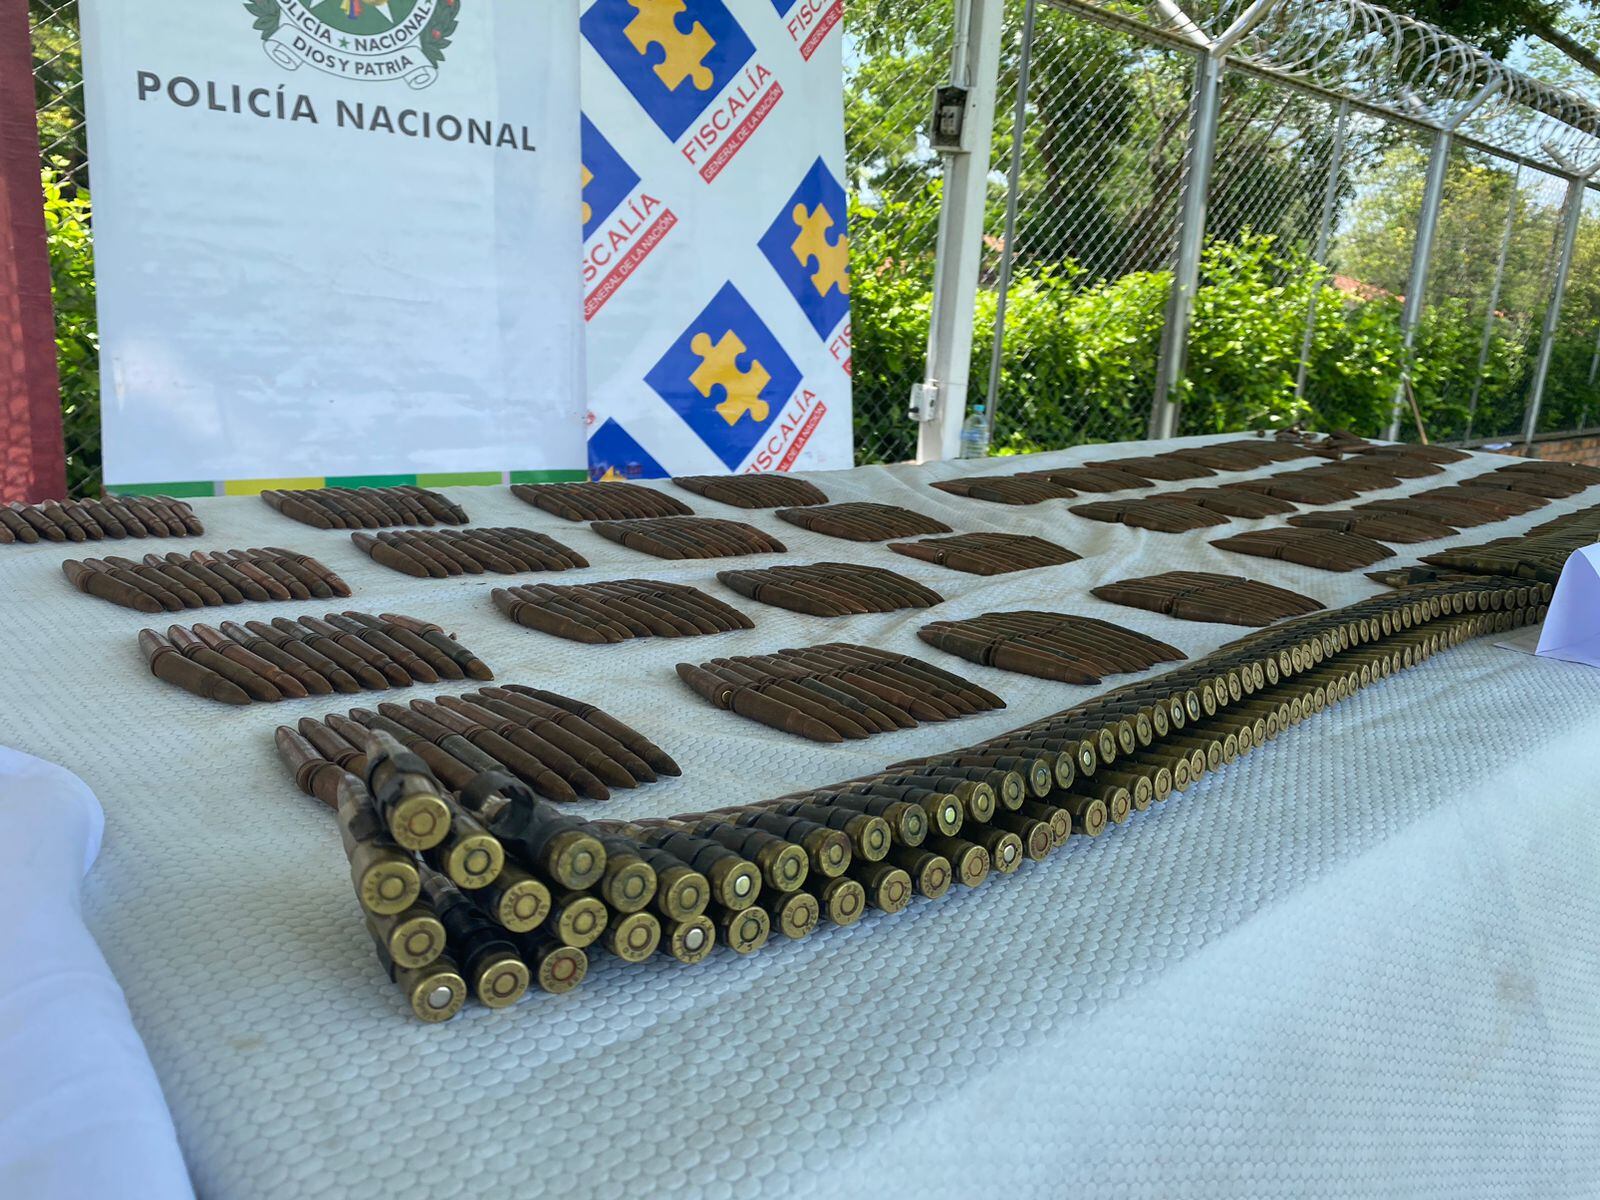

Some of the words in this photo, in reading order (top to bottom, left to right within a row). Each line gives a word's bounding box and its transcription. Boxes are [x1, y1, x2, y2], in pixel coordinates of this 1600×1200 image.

[355, 0, 431, 52] NACIONAL
[787, 0, 826, 41] FISC
[292, 35, 336, 68] DIOS
[355, 55, 414, 76] PATRIA
[136, 70, 319, 125] POLICÍA
[336, 99, 537, 152] NACIONAL
[681, 64, 771, 165] FISCALÍA
[703, 138, 740, 179] GENERAL
[736, 125, 750, 142] DE
[748, 115, 759, 129] LA
[582, 193, 661, 287] SCALÍA
[618, 259, 634, 276] DE
[631, 248, 645, 261] LA
[641, 213, 675, 250] NACIÓN
